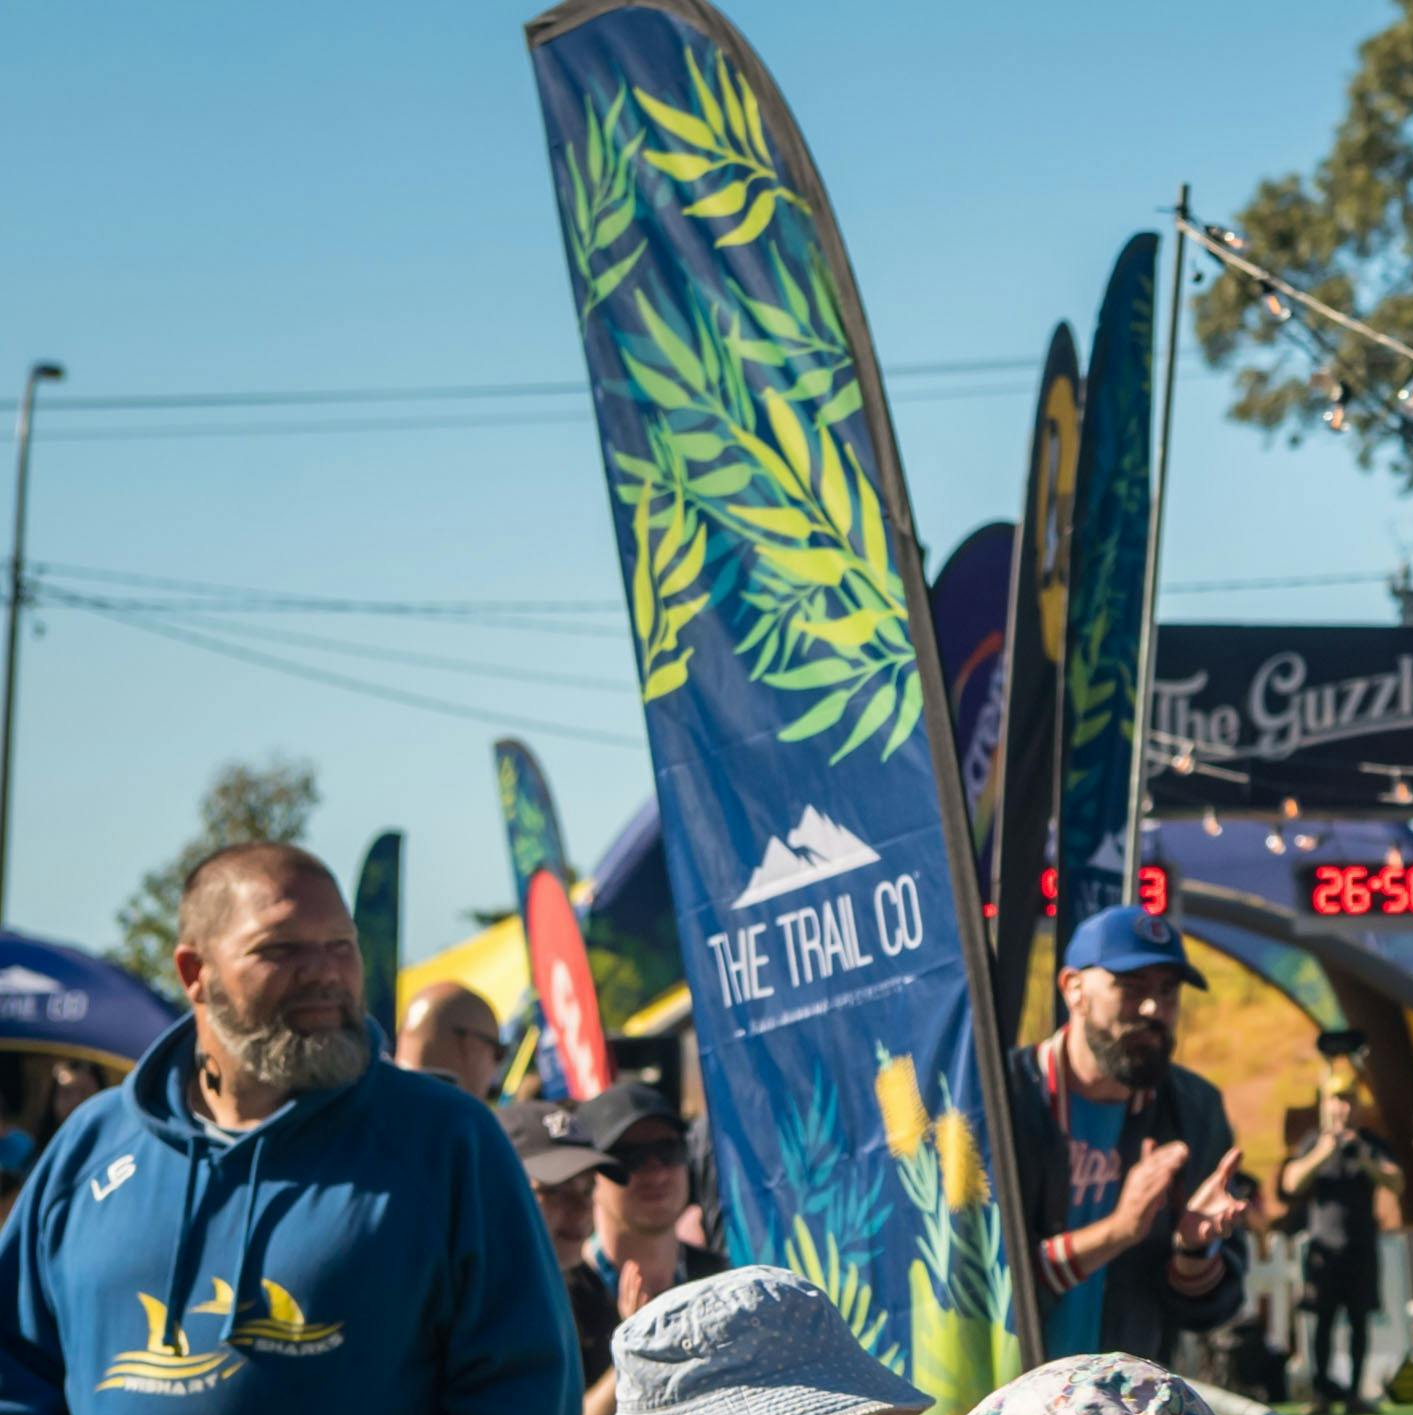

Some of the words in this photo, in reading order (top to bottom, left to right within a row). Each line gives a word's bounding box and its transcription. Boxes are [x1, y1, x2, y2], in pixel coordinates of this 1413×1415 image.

[1148, 668, 1241, 748] The
[707, 922, 775, 1009] THE
[775, 893, 875, 988] TRAIL
[873, 873, 924, 957] CO
[254, 1332, 344, 1356] SHARKS
